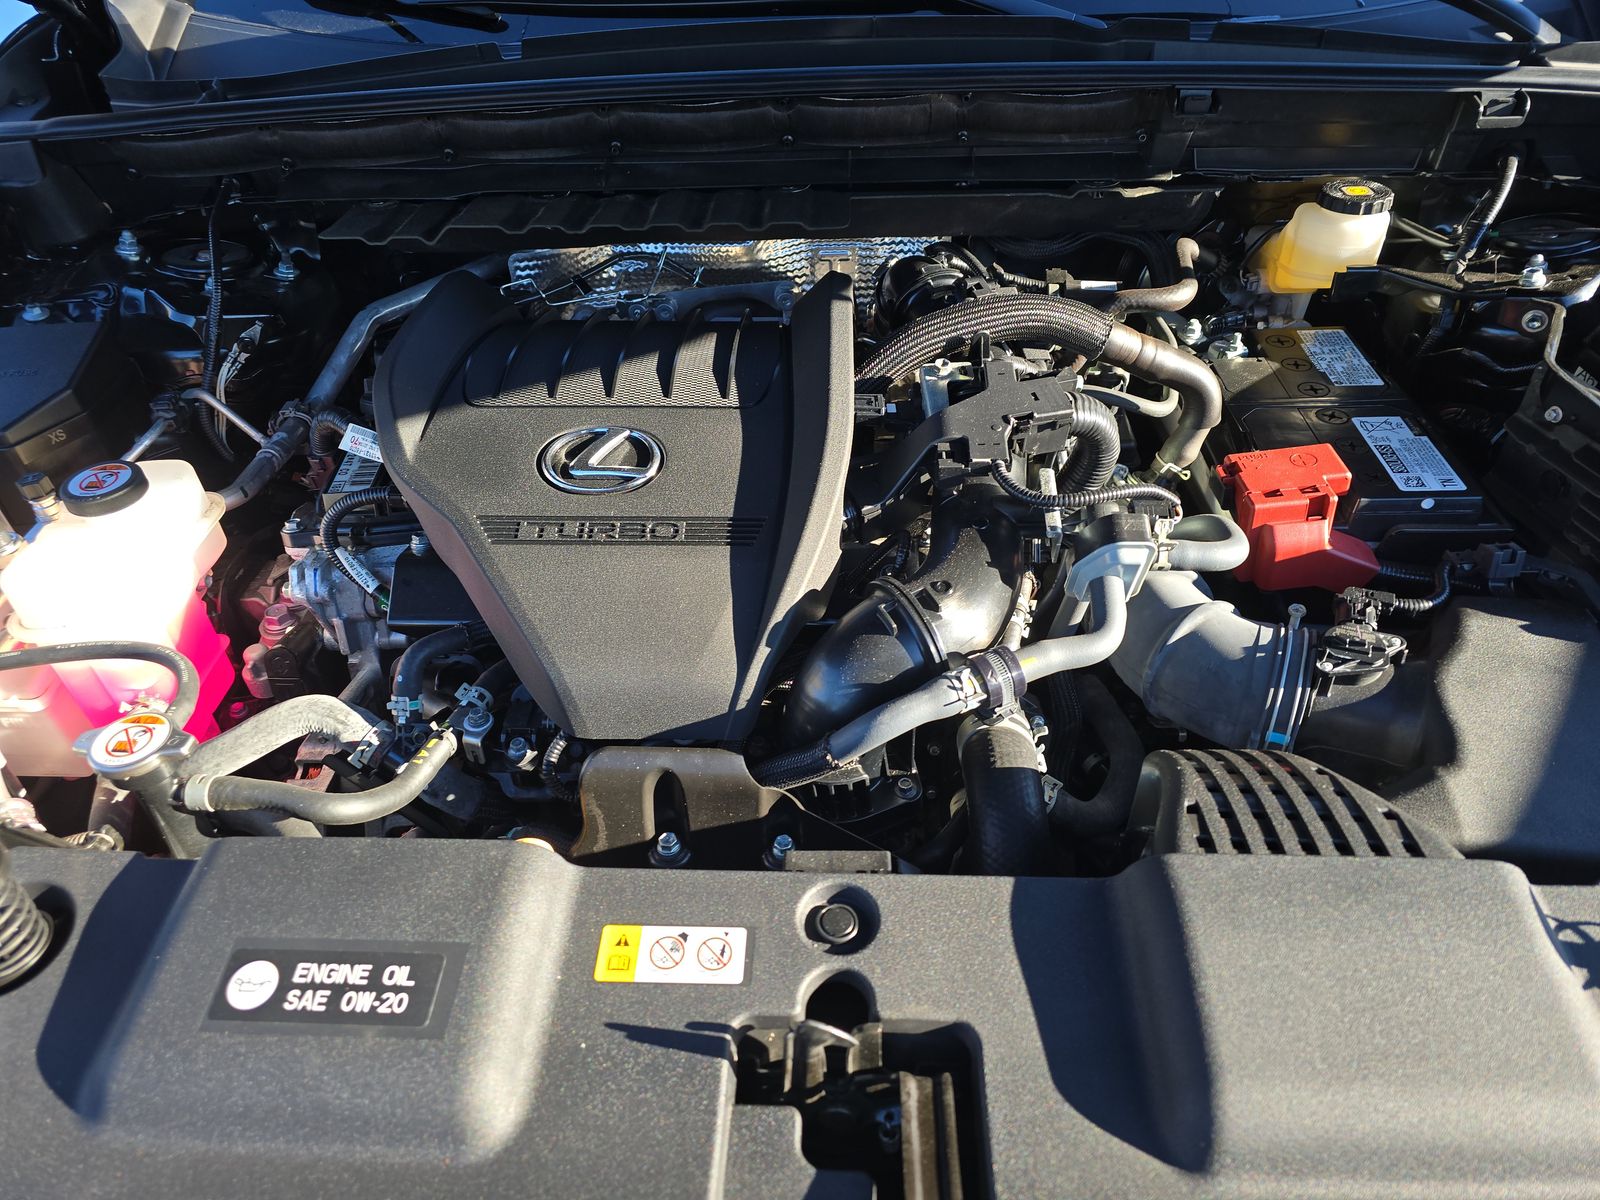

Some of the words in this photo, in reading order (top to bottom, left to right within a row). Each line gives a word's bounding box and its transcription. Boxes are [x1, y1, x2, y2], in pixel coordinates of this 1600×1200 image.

[47, 428, 67, 445] XS
[517, 520, 685, 541] TURBO
[291, 962, 373, 985] ENGINE
[381, 964, 416, 987] OIL
[282, 989, 332, 1012] SAE
[339, 991, 409, 1014] 0W-20
